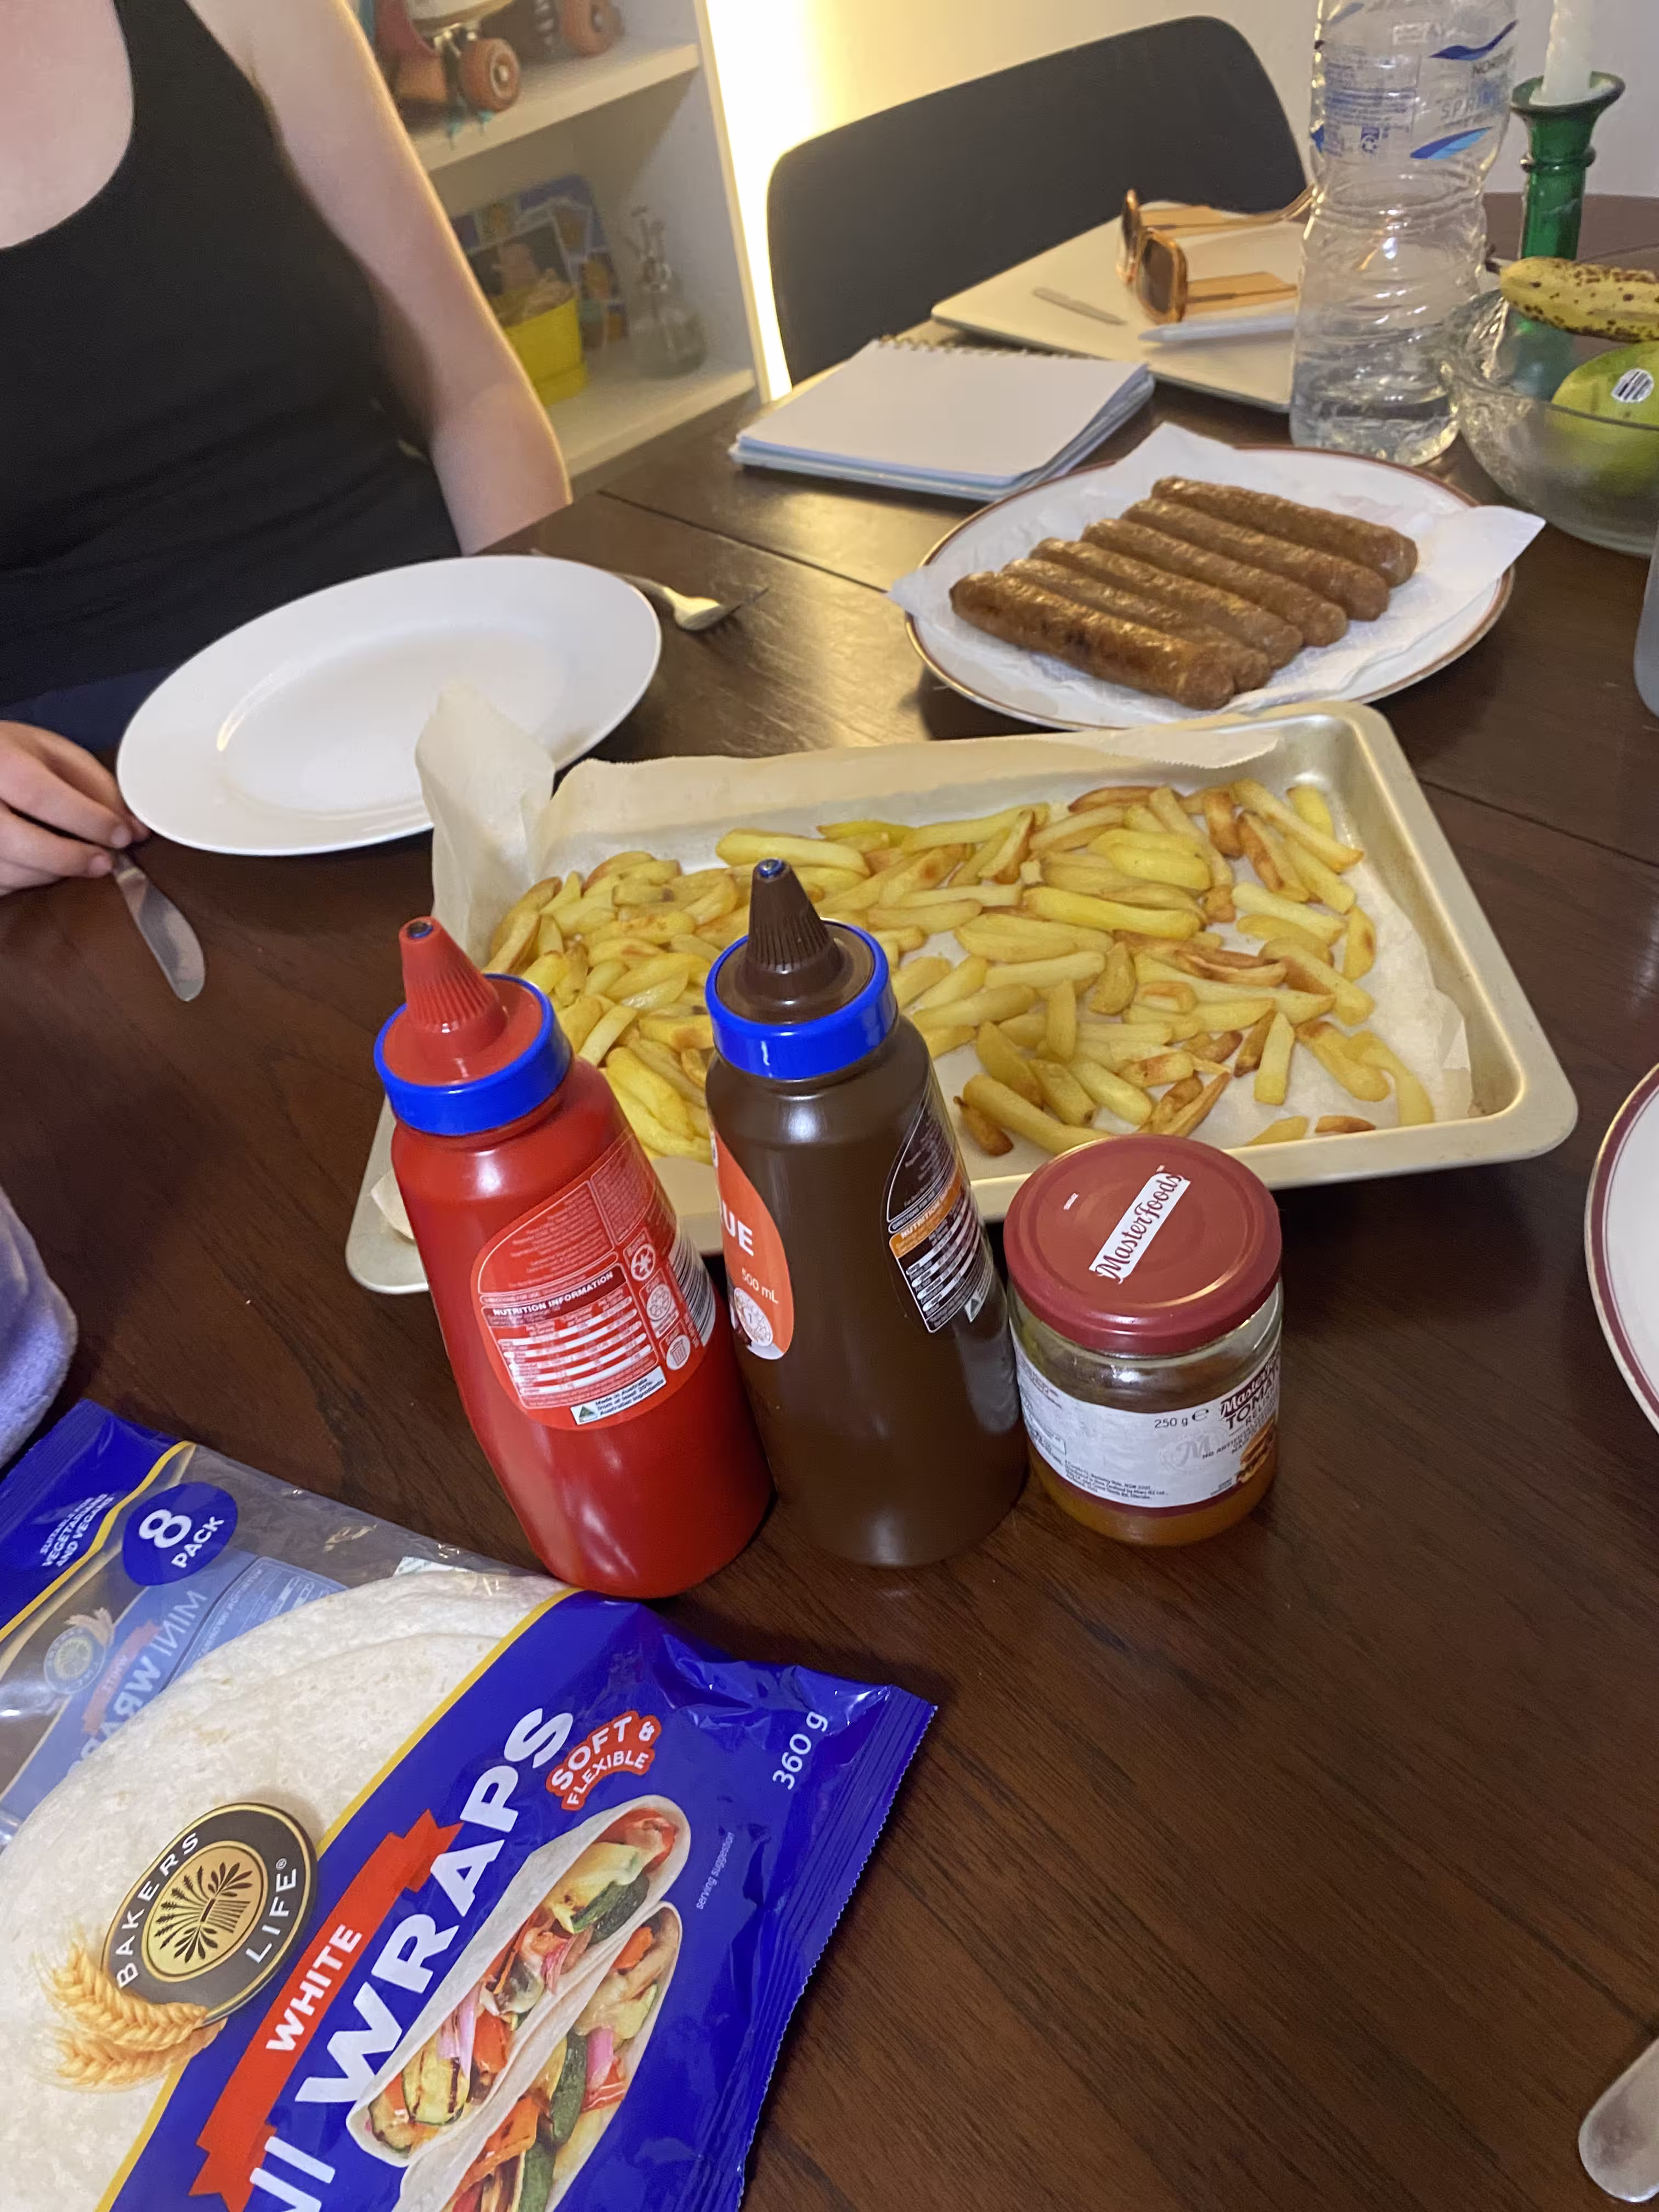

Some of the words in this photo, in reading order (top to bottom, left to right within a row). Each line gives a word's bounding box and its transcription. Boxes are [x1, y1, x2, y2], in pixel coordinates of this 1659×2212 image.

[1095, 1173, 1182, 1285] MasterFoods
[493, 1302, 546, 1316] NUTRITION
[548, 1271, 614, 1307] INFORMATION
[742, 1267, 759, 1291] 500
[761, 1286, 779, 1304] mL
[1154, 1418, 1177, 1429] 250
[1181, 1418, 1188, 1427] g
[42, 1493, 109, 1567] VEGETARIANS
[55, 1541, 78, 1567] AND
[72, 1497, 115, 1539] VEGANS
[139, 1508, 192, 1549] 8
[171, 1516, 224, 1568] PACK
[551, 1716, 633, 1790] SOFT
[639, 1721, 655, 1742] &
[566, 1750, 650, 1805] FLEXIBLE
[772, 1733, 812, 1790] 360
[806, 1711, 828, 1733] g
[295, 1707, 574, 2103] WRAPS
[696, 1876, 718, 1910] serving
[711, 1831, 735, 1877] suggestion
[115, 1832, 199, 1989] BAKERS
[266, 1923, 363, 2054] WHITE
